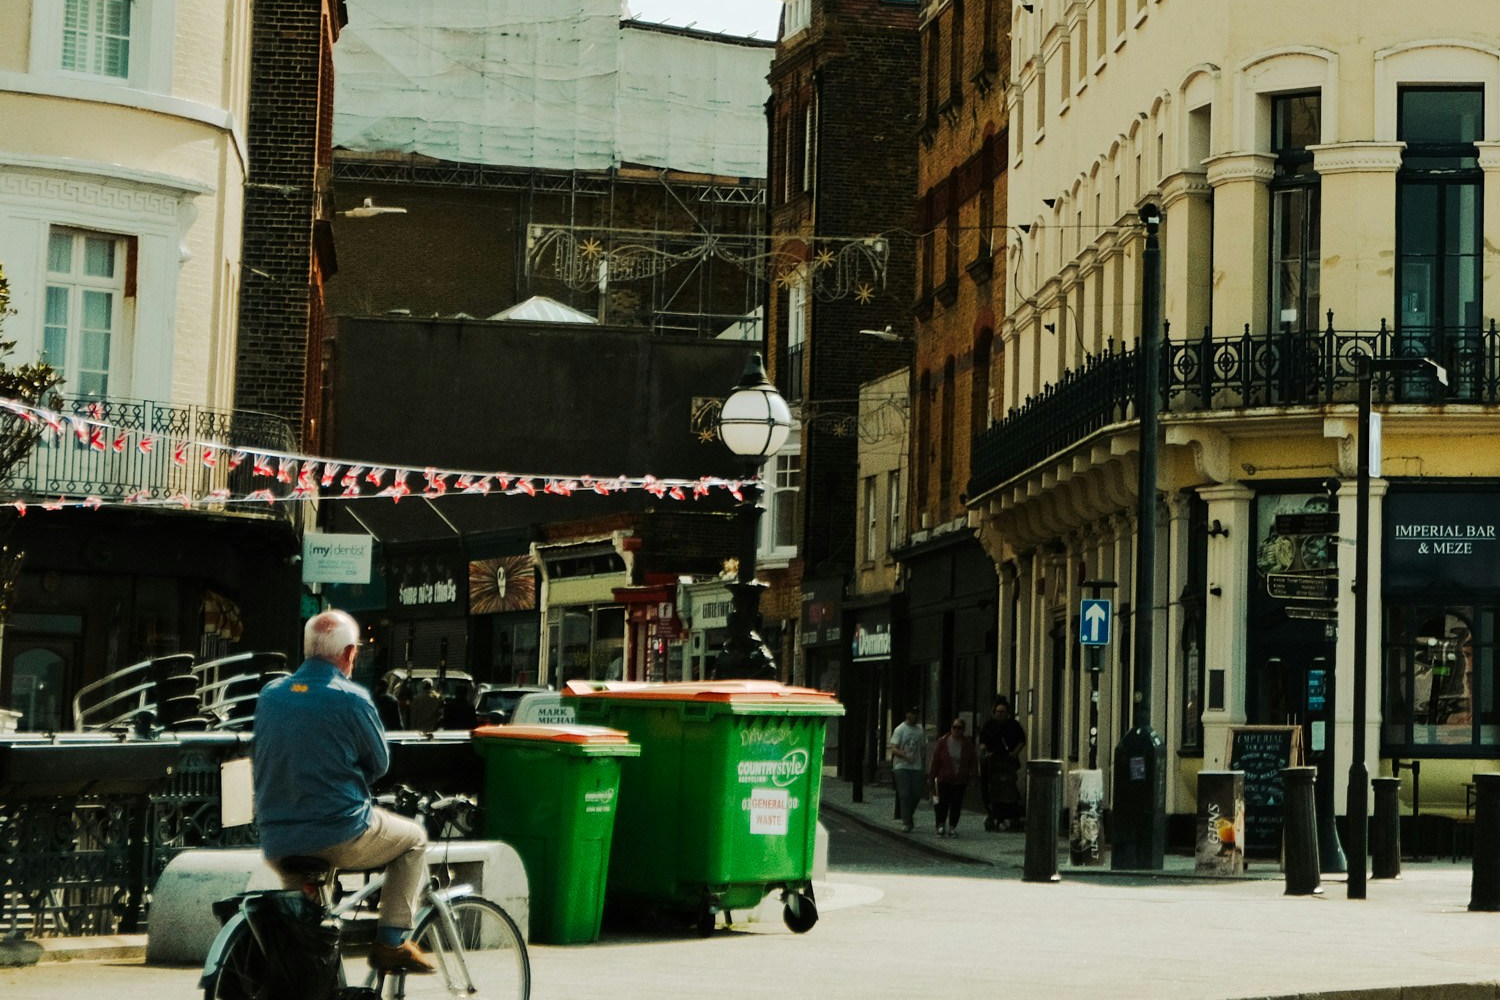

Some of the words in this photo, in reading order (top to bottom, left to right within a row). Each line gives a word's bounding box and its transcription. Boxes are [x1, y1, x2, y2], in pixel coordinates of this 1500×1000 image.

[1395, 525, 1463, 537] IMPERIAL
[1466, 525, 1496, 537] BAR
[1418, 542, 1429, 554] &
[1433, 542, 1472, 554] MEZE
[539, 708, 566, 716] MARK
[752, 799, 786, 809] GENERAL
[756, 815, 781, 825] WASTE
[1208, 803, 1220, 844] GINS
